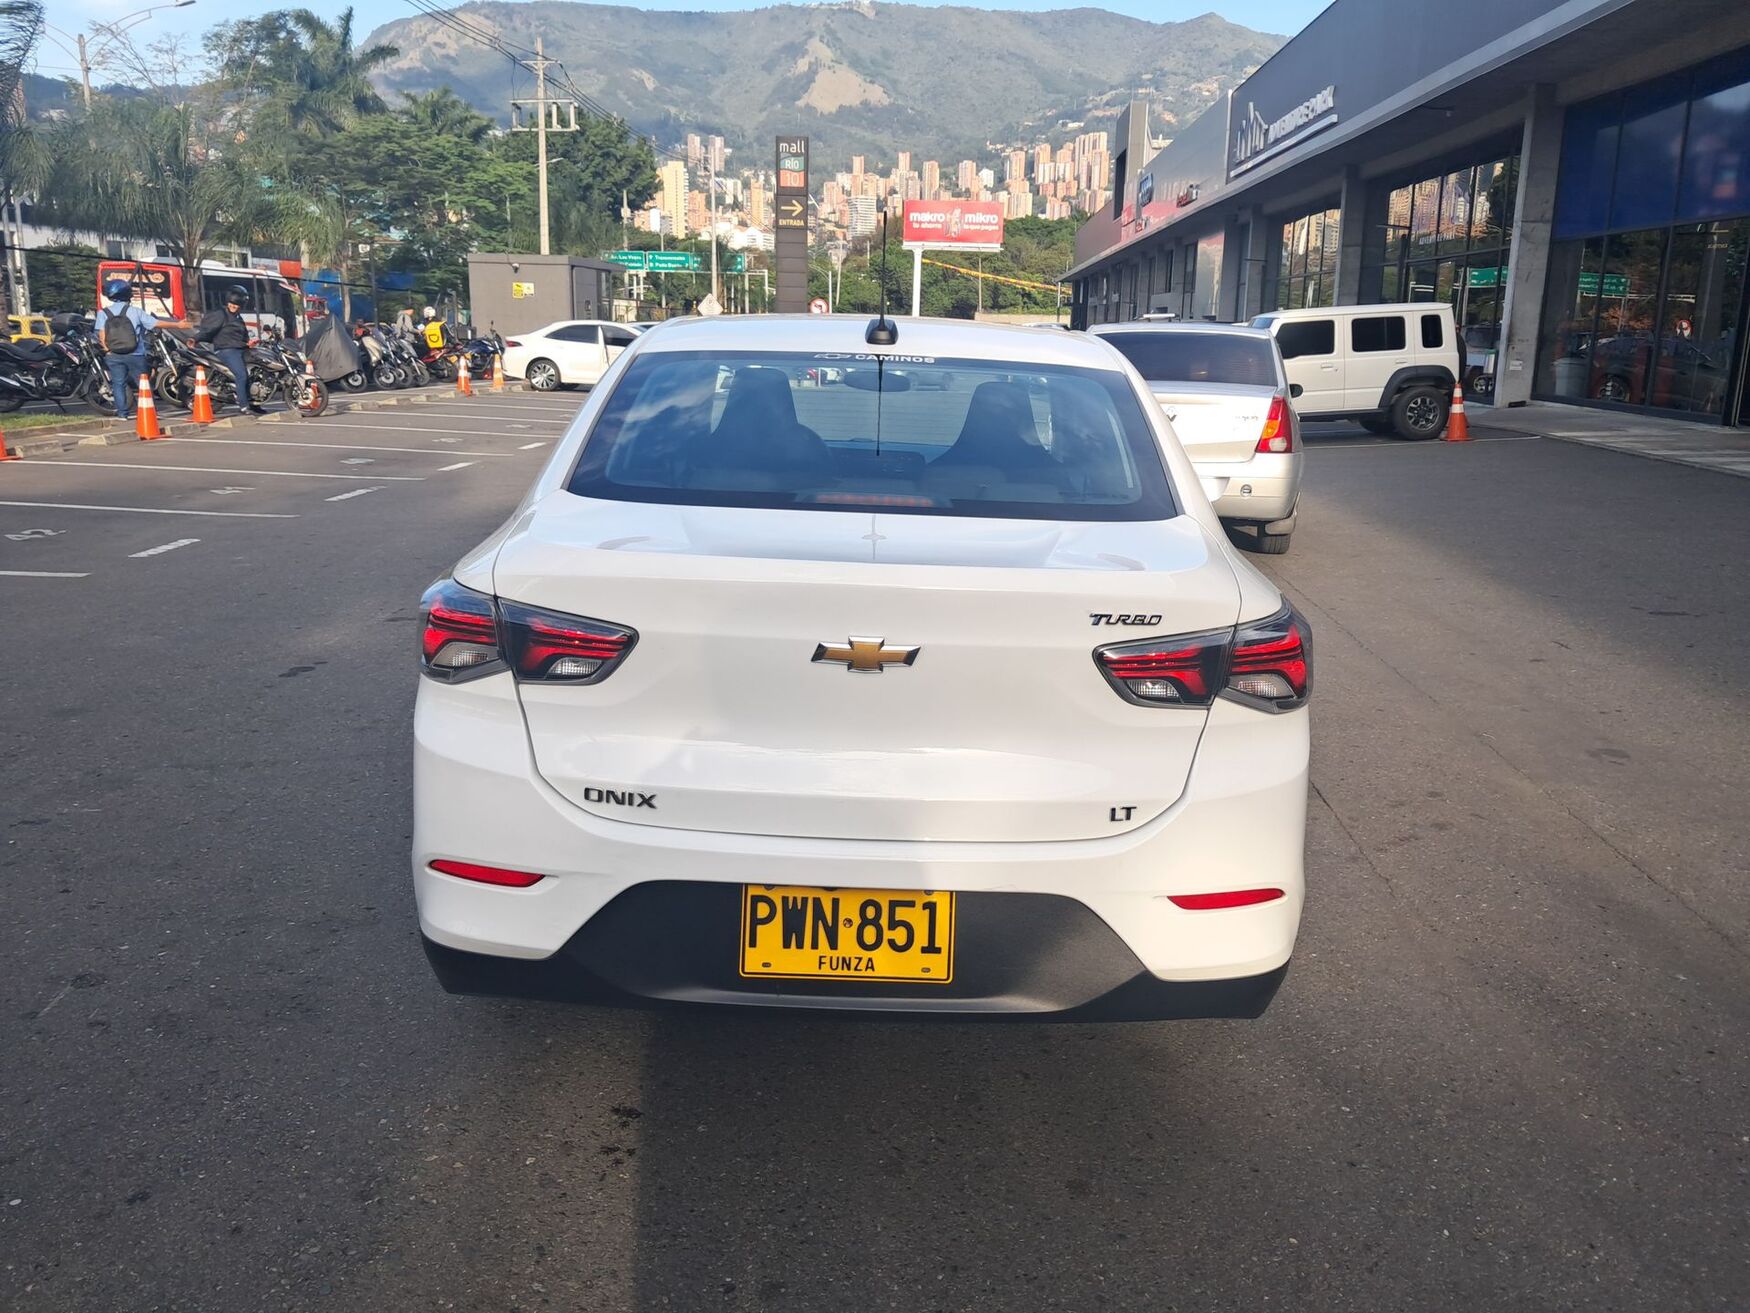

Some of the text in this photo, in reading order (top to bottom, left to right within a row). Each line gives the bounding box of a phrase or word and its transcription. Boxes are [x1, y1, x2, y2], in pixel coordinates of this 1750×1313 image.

[779, 140, 805, 153] mall
[785, 173, 799, 186] 10
[909, 211, 998, 224] makro mikro
[855, 354, 935, 364] CAMINOS
[1089, 613, 1163, 626] TURBO
[584, 787, 658, 810] ONIX
[1109, 806, 1137, 822] LT
[748, 894, 942, 954] PWN 851
[818, 955, 876, 972] FUNZA
